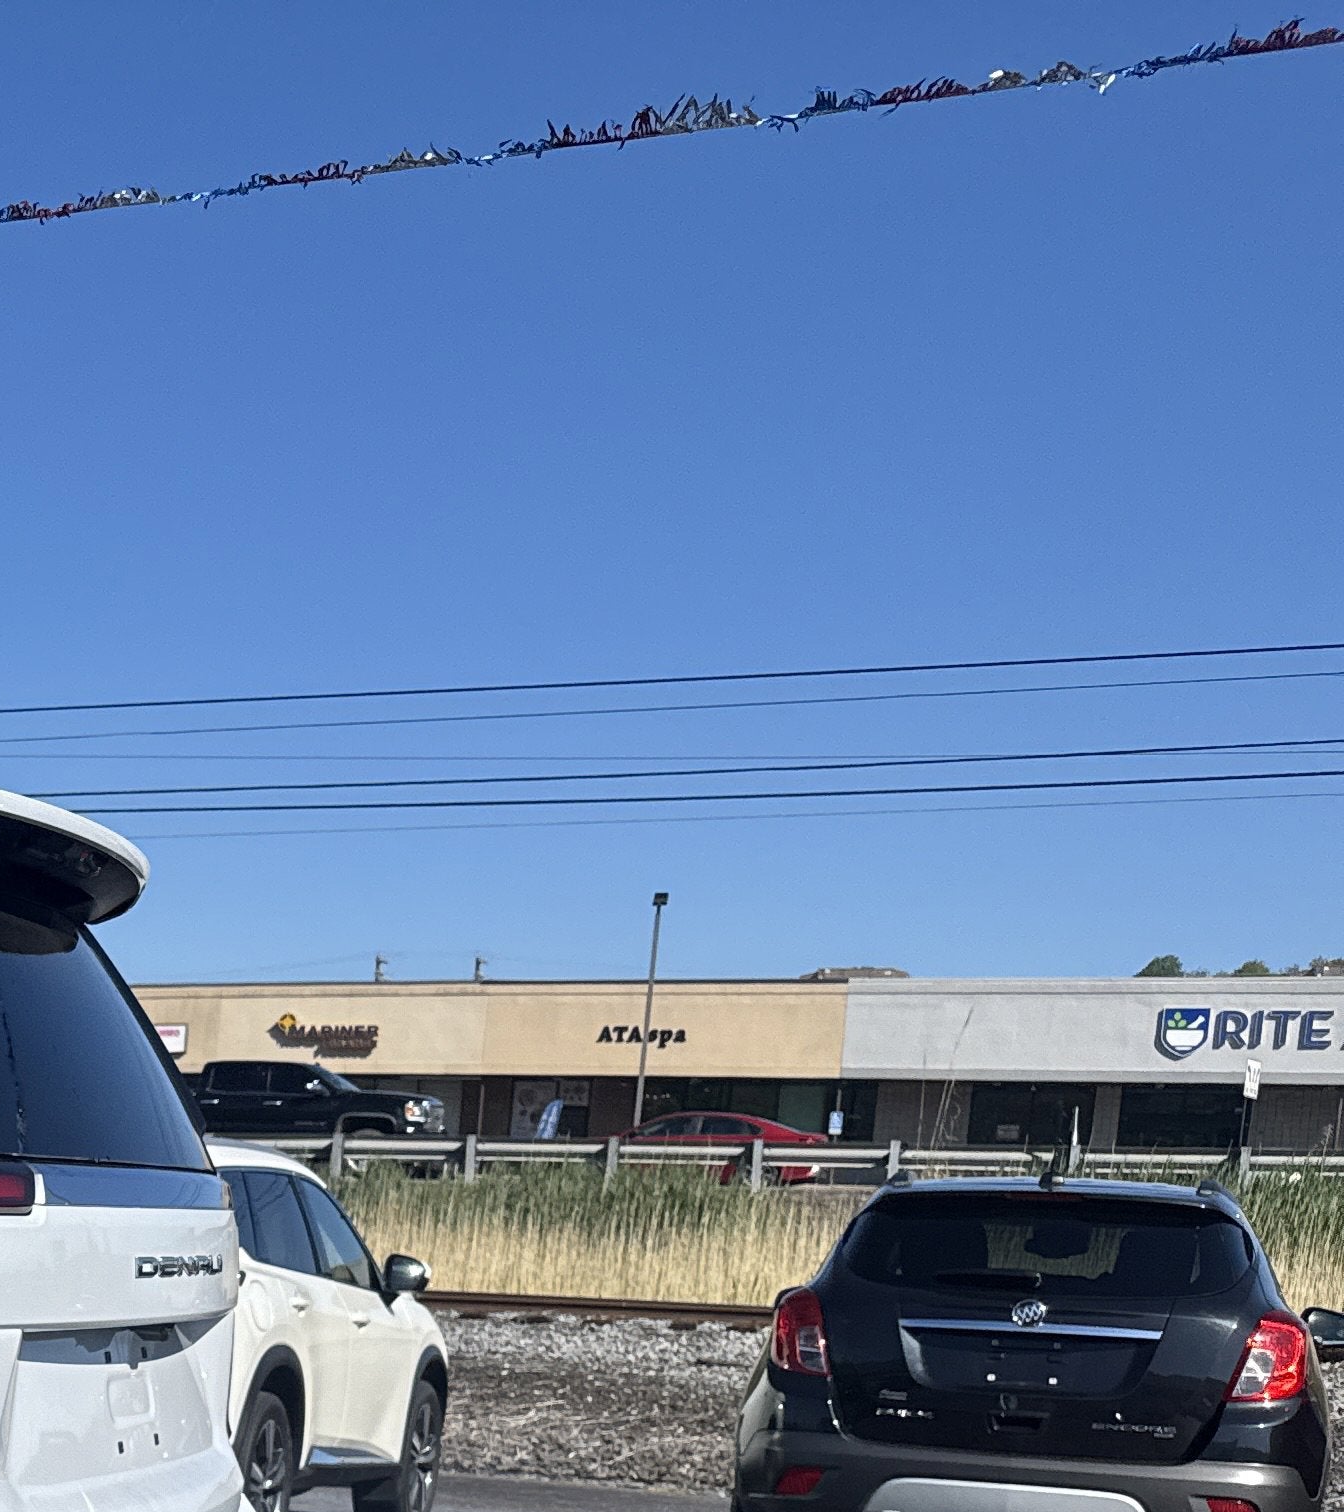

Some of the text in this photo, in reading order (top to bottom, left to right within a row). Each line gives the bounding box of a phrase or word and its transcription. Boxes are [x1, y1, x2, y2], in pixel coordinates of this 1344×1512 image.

[287, 1024, 379, 1038] MARINER
[1212, 1009, 1335, 1051] RITE
[135, 1253, 223, 1279] DENALI
